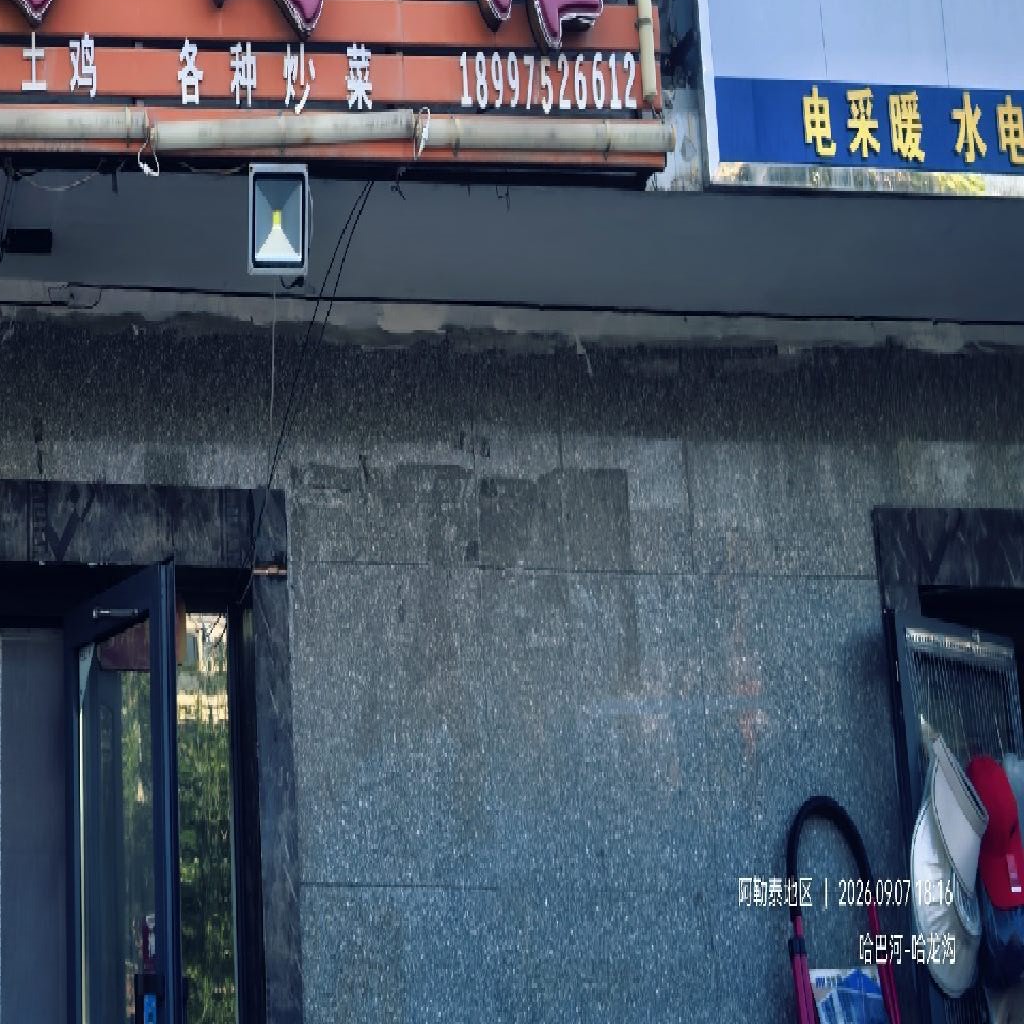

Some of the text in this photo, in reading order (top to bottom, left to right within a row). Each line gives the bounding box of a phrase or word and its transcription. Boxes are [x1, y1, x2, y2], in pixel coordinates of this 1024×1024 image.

[178, 36, 373, 114] 各种炒菜
[459, 51, 638, 115] 18997526612
[802, 84, 1024, 165] 电采暖 水电
